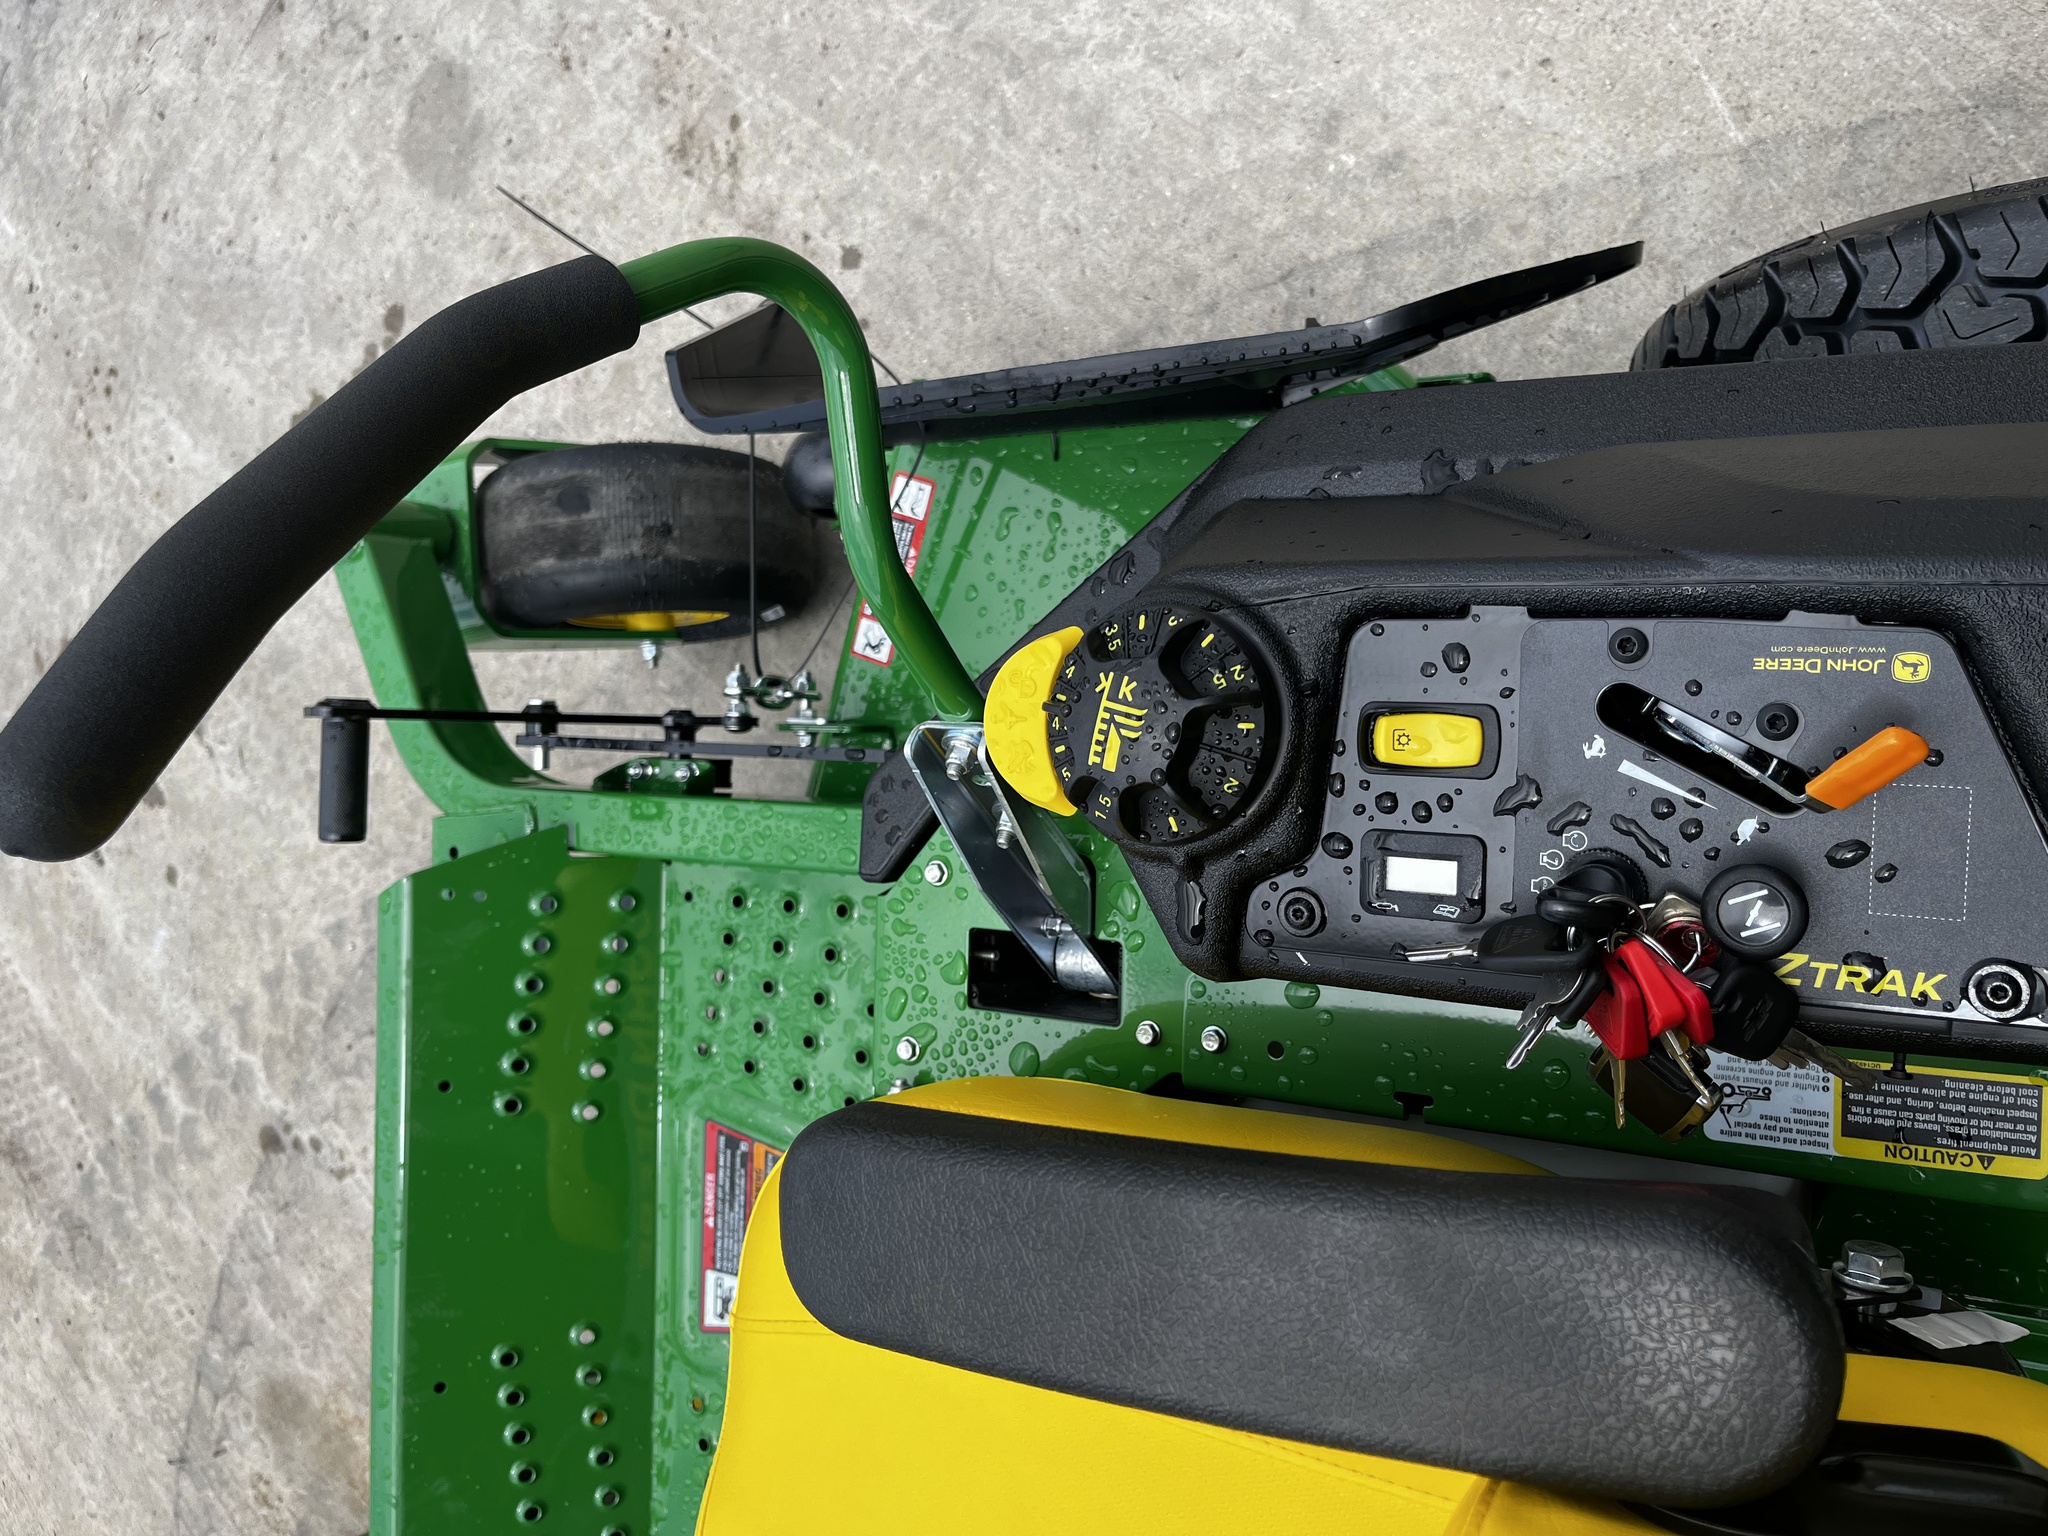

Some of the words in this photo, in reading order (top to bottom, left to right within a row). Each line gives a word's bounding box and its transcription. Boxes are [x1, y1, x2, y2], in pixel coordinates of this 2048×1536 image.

[1105, 623, 1121, 651] 3.5
[1771, 645, 1887, 654] www.JohnDeere.com
[1752, 658, 1821, 674] DEERE
[1826, 658, 1886, 675] JOHN
[1065, 665, 1075, 679] 4
[1213, 664, 1245, 690] 2.5
[1224, 778, 1239, 793] 2
[1095, 794, 1111, 820] 1.5
[1774, 952, 1948, 1001] ZTRAK
[1727, 1056, 1741, 1065] and
[1716, 1064, 1746, 1074] screens
[1748, 1066, 1774, 1076] engine
[1713, 1073, 1740, 1084] system
[1776, 1070, 1790, 1079] and
[1794, 1072, 1820, 1082] Engine
[1742, 1076, 1772, 1086] exhaust
[1774, 1080, 1789, 1088] and
[1941, 1078, 1984, 1092] cleaning.
[1792, 1081, 1820, 1092] Muffler
[1880, 1083, 1918, 1094] machine
[1986, 1085, 2016, 1095] before
[1846, 1092, 1863, 1100] use.
[1921, 1087, 1946, 1097] allow
[1949, 1090, 1966, 1099] and
[1968, 1092, 2000, 1102] engine
[2018, 1088, 2038, 1096] cool
[1864, 1094, 1884, 1103] after
[1886, 1096, 1902, 1104] and
[1904, 1096, 1934, 1109] during,
[2002, 1096, 2014, 1104] off
[2017, 1096, 2038, 1107] Shut
[1790, 1107, 1829, 1118] locations:
[1848, 1105, 1864, 1114] fire.
[1873, 1108, 1896, 1116] cause
[1934, 1102, 1966, 1113] before,
[1968, 1105, 2004, 1116] machine
[1760, 1113, 1780, 1123] these
[1847, 1114, 1872, 1124] debris
[1898, 1110, 1913, 1118] can
[1915, 1112, 1935, 1122] parts
[1938, 1113, 1968, 1124] moving
[2006, 1109, 2038, 1120] Inspect
[1734, 1120, 1761, 1130] special
[1783, 1116, 1790, 1124] to
[1793, 1118, 1829, 1128] attention
[1874, 1116, 1894, 1126] other
[1896, 1119, 1912, 1128] and
[1970, 1118, 1978, 1126] or
[1980, 1120, 1993, 1128] hot
[1764, 1122, 1776, 1132] pay
[1779, 1126, 1793, 1134] and
[1914, 1121, 1940, 1132] leaves
[1942, 1124, 1968, 1134] grass,
[1994, 1122, 2014, 1130] near
[2026, 1124, 2037, 1132] on
[1720, 1128, 1742, 1138] entire
[1744, 1132, 1756, 1140] the
[1796, 1128, 1829, 1138] machine
[1970, 1128, 1978, 1136] of
[1980, 1128, 2037, 1143] Accumulation
[1759, 1134, 1780, 1143] clean
[1782, 1136, 1797, 1146] and
[1934, 1136, 1957, 1148] fires.
[1800, 1138, 1828, 1150] Inspect
[1960, 1140, 2008, 1152] equipment
[2011, 1145, 2036, 1156] Avoid
[1884, 1144, 1974, 1168] CAUTION
